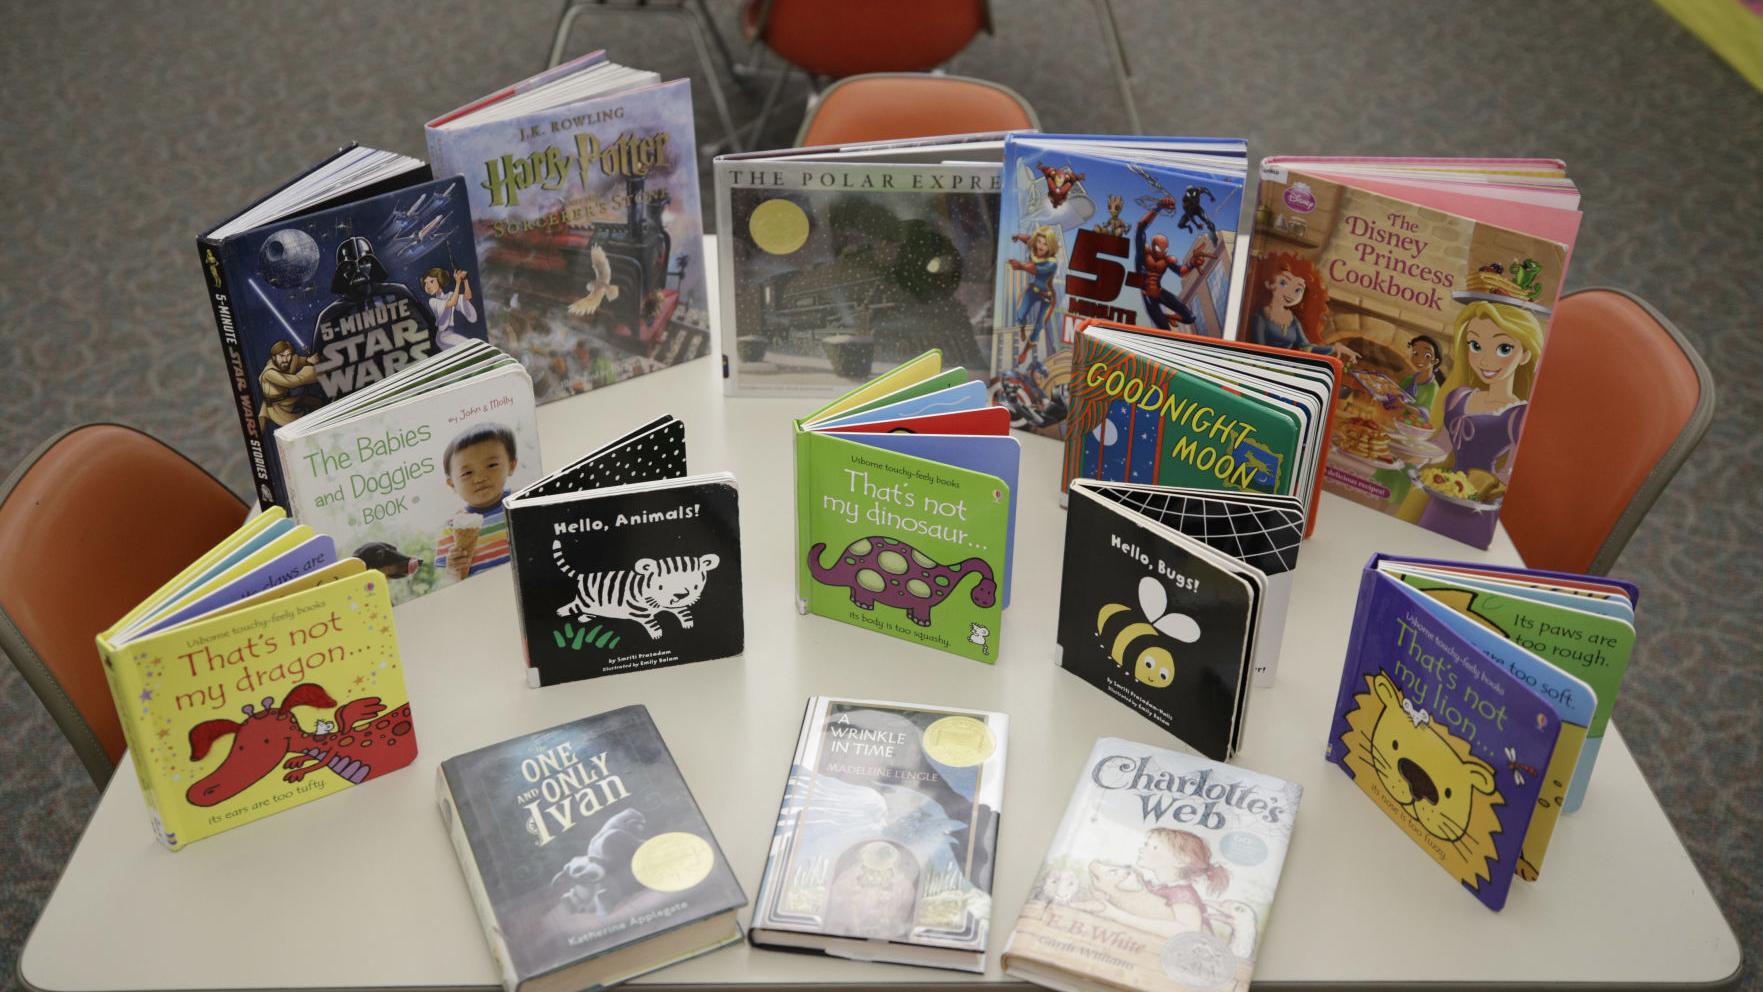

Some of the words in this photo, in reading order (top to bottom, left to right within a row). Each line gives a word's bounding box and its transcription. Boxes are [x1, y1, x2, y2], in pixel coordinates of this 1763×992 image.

[519, 125, 545, 142] J.K.
[551, 106, 625, 134] ROWLING
[481, 144, 573, 208] Harry
[573, 130, 671, 191] Potter
[729, 170, 785, 187] THE
[802, 172, 896, 189] POLAR
[1345, 215, 1429, 260] Disney
[1387, 212, 1419, 234] The
[1329, 258, 1444, 313] Cookbook
[1354, 242, 1455, 288] Princess
[215, 293, 238, 345] 5-MINUTE
[320, 298, 411, 339] 5-MINUTE
[1068, 297, 1137, 325] MINUTE
[314, 319, 430, 374] STAR
[229, 346, 248, 392] STAR
[317, 339, 432, 400] WARS
[239, 394, 258, 437] WARS
[459, 406, 481, 420] John
[490, 396, 514, 410] Molly
[1086, 362, 1258, 449] GOODNIGHT
[250, 439, 268, 480] STORIES
[304, 447, 351, 479] The
[356, 423, 433, 463] Babies
[851, 455, 883, 470] Usborne
[885, 465, 934, 485] touchy-feely
[936, 475, 961, 489] books
[1171, 435, 1259, 489] MOON
[315, 485, 345, 509] and
[350, 456, 436, 500] Doggies
[844, 468, 915, 508] That's
[924, 494, 968, 521] not
[362, 495, 409, 526] BOOK
[554, 517, 609, 536] Hello,
[615, 503, 701, 529] Animals!
[824, 494, 860, 524] my
[303, 553, 326, 571] are
[1111, 533, 1154, 571] Hello,
[1157, 558, 1200, 593] Bugs!
[178, 633, 279, 678] That's
[288, 611, 343, 646] not
[861, 613, 884, 630] body
[886, 622, 893, 630] is
[895, 624, 912, 635] too
[913, 631, 951, 648] squashy.
[1514, 613, 1534, 629] Its
[1540, 619, 1583, 642] paws
[1588, 633, 1618, 649] are
[1515, 633, 1547, 652] too
[1552, 642, 1609, 668] rough.
[1395, 660, 1427, 705] my
[1396, 616, 1457, 690] That's
[1464, 685, 1509, 731] not
[1509, 662, 1537, 687] too
[1541, 683, 1575, 710] soft.
[175, 683, 225, 710] my
[830, 726, 907, 745] WRINKLE
[837, 713, 850, 725] A
[521, 741, 579, 783] ONE
[826, 763, 894, 777] MADELEINE
[831, 741, 849, 753] IN
[852, 742, 894, 759] TIME
[517, 788, 539, 806] AND
[541, 751, 609, 803] ONLY
[1092, 755, 1284, 824] Charlotte's
[225, 806, 249, 819] ears
[251, 798, 270, 810] are
[272, 790, 294, 802] too
[522, 773, 632, 847] Ivan
[1137, 792, 1227, 830] Web
[568, 922, 627, 946] Katherine
[630, 901, 689, 928] Applegate
[1092, 926, 1147, 954] White
